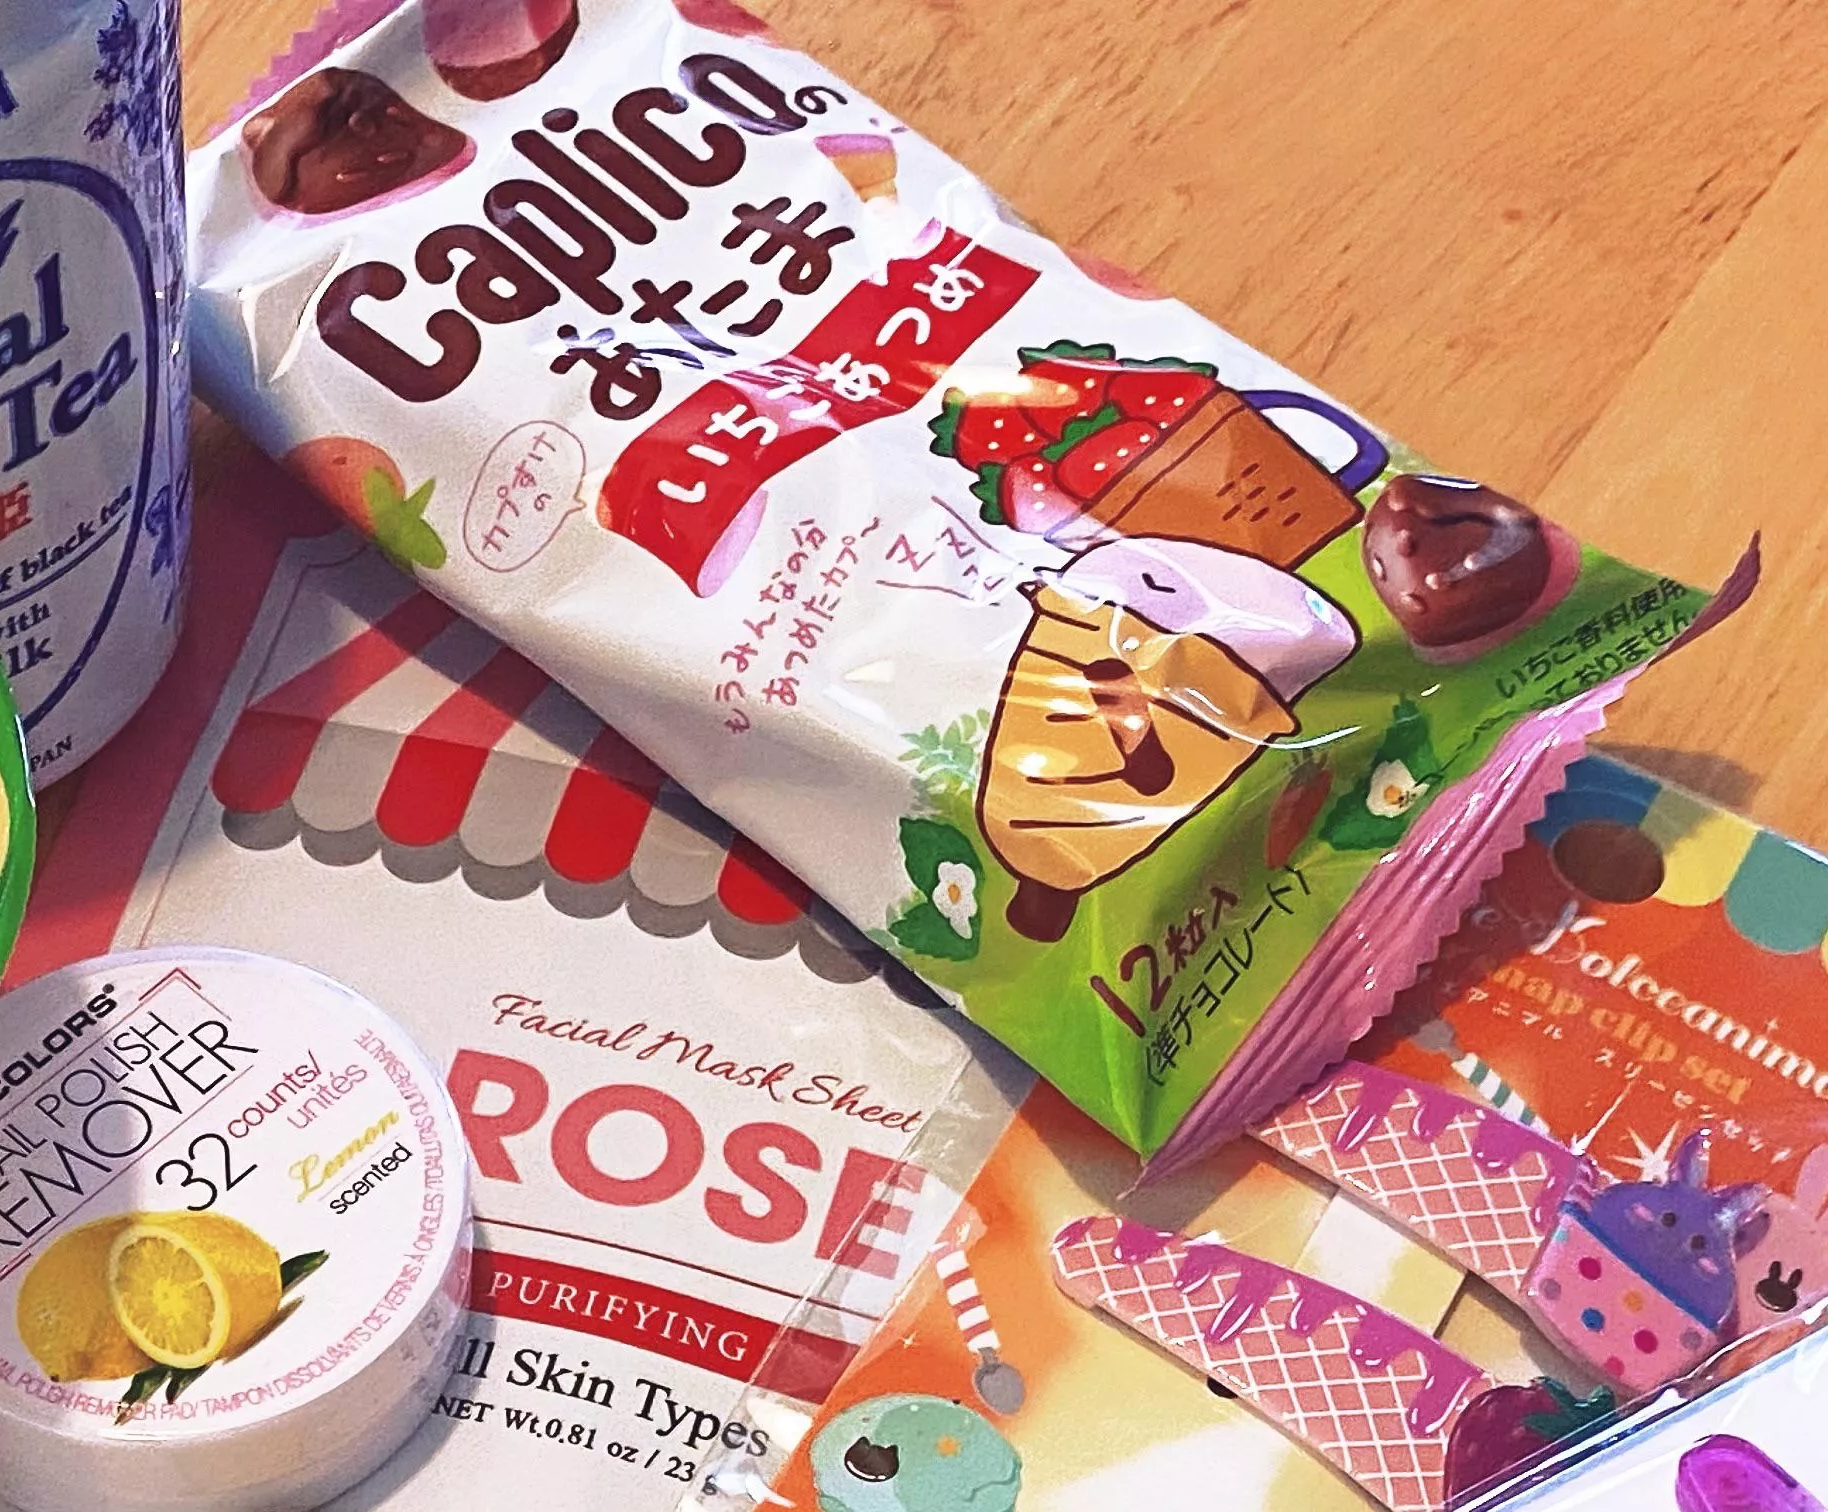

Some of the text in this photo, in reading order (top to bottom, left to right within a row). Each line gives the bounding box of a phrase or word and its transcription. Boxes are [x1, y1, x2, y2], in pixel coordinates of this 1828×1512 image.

[22, 520, 95, 576] black
[35, 1009, 181, 1128] POLISH
[287, 1063, 369, 1131] unités
[492, 993, 924, 1135] Facial Mask Sheet
[154, 1132, 259, 1212] 32
[289, 1110, 401, 1202] Lemon
[329, 1142, 413, 1215] scented
[446, 1048, 929, 1281] ROSE
[487, 1268, 752, 1365] PURIFYING
[432, 1394, 494, 1424] NET
[606, 1441, 640, 1464] oz
[664, 1456, 698, 1483] 23
[506, 1348, 616, 1408] Skin
[633, 1377, 772, 1458] Types
